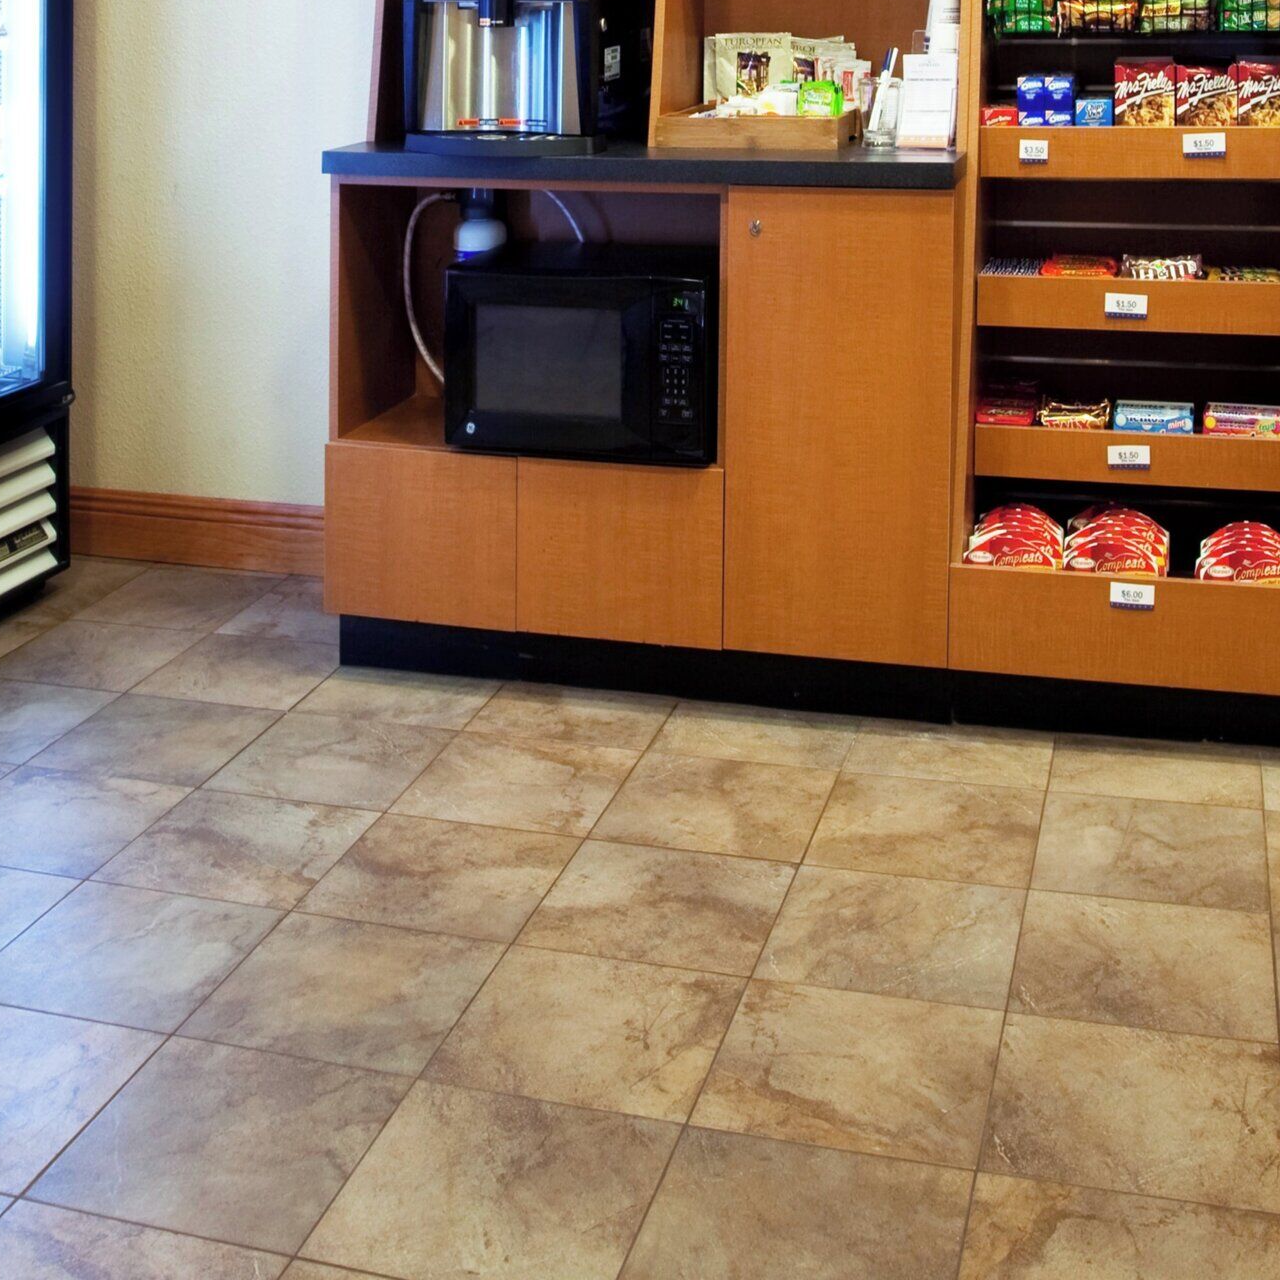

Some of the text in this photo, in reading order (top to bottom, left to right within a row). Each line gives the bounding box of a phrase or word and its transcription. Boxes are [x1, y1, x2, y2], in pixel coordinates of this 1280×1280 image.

[724, 37, 782, 47] EUROPEAN
[1193, 138, 1214, 148] $1.50
[1024, 145, 1045, 155] $3.50
[1115, 299, 1137, 309] $1.50
[1118, 451, 1139, 461] $1.50
[992, 552, 1044, 568] Compleats
[1096, 558, 1147, 574] Compleats
[1121, 589, 1144, 600] $6.00
